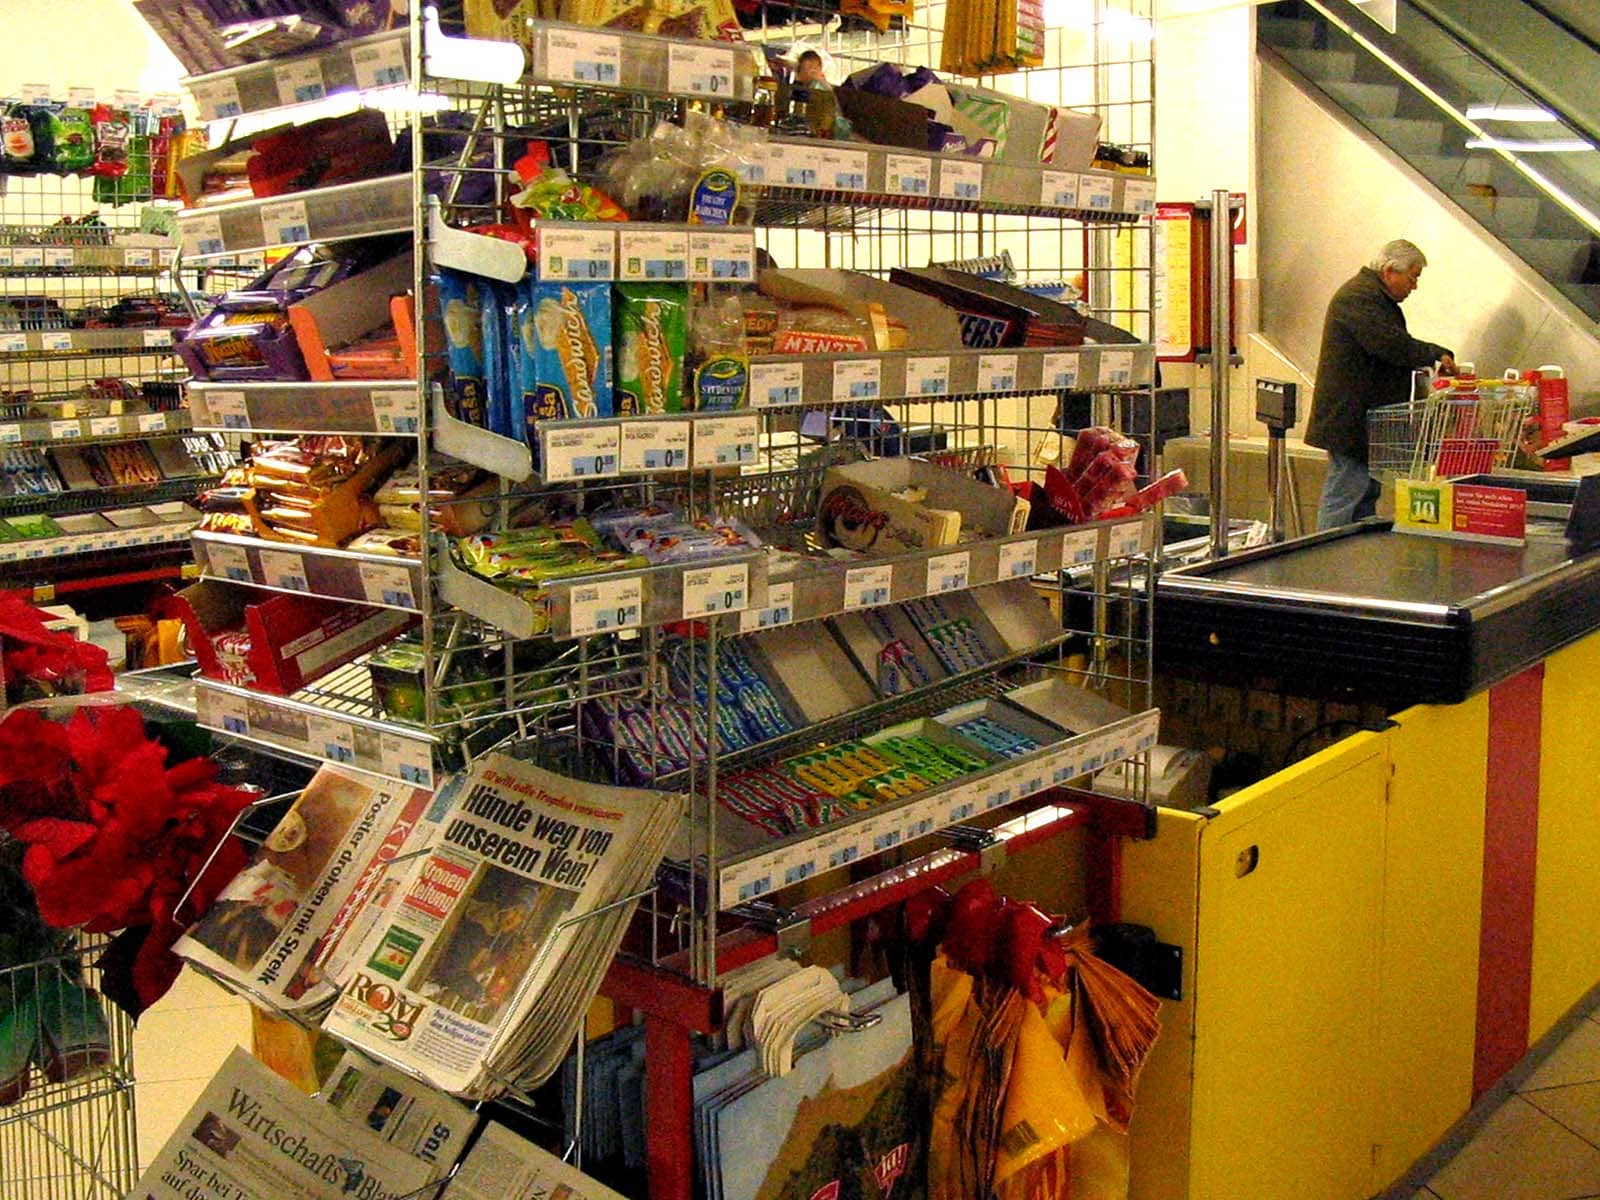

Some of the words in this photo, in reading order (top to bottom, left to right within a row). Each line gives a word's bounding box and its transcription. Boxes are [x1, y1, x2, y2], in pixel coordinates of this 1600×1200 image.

[556, 293, 599, 417] Sandwich
[349, 791, 392, 850] Postler
[460, 783, 532, 833] Hände
[532, 813, 579, 851] weg
[577, 827, 614, 859] von
[311, 849, 354, 909] drohen
[443, 818, 541, 875] unserem
[539, 847, 598, 888] Wein!
[294, 905, 317, 938] mit
[257, 936, 300, 986] Streik
[343, 972, 425, 1028] ROM
[226, 1086, 343, 1185] Wirtschafts
[161, 1170, 191, 1192] auf
[175, 1149, 208, 1179] Spar
[206, 1171, 233, 1198] bei
